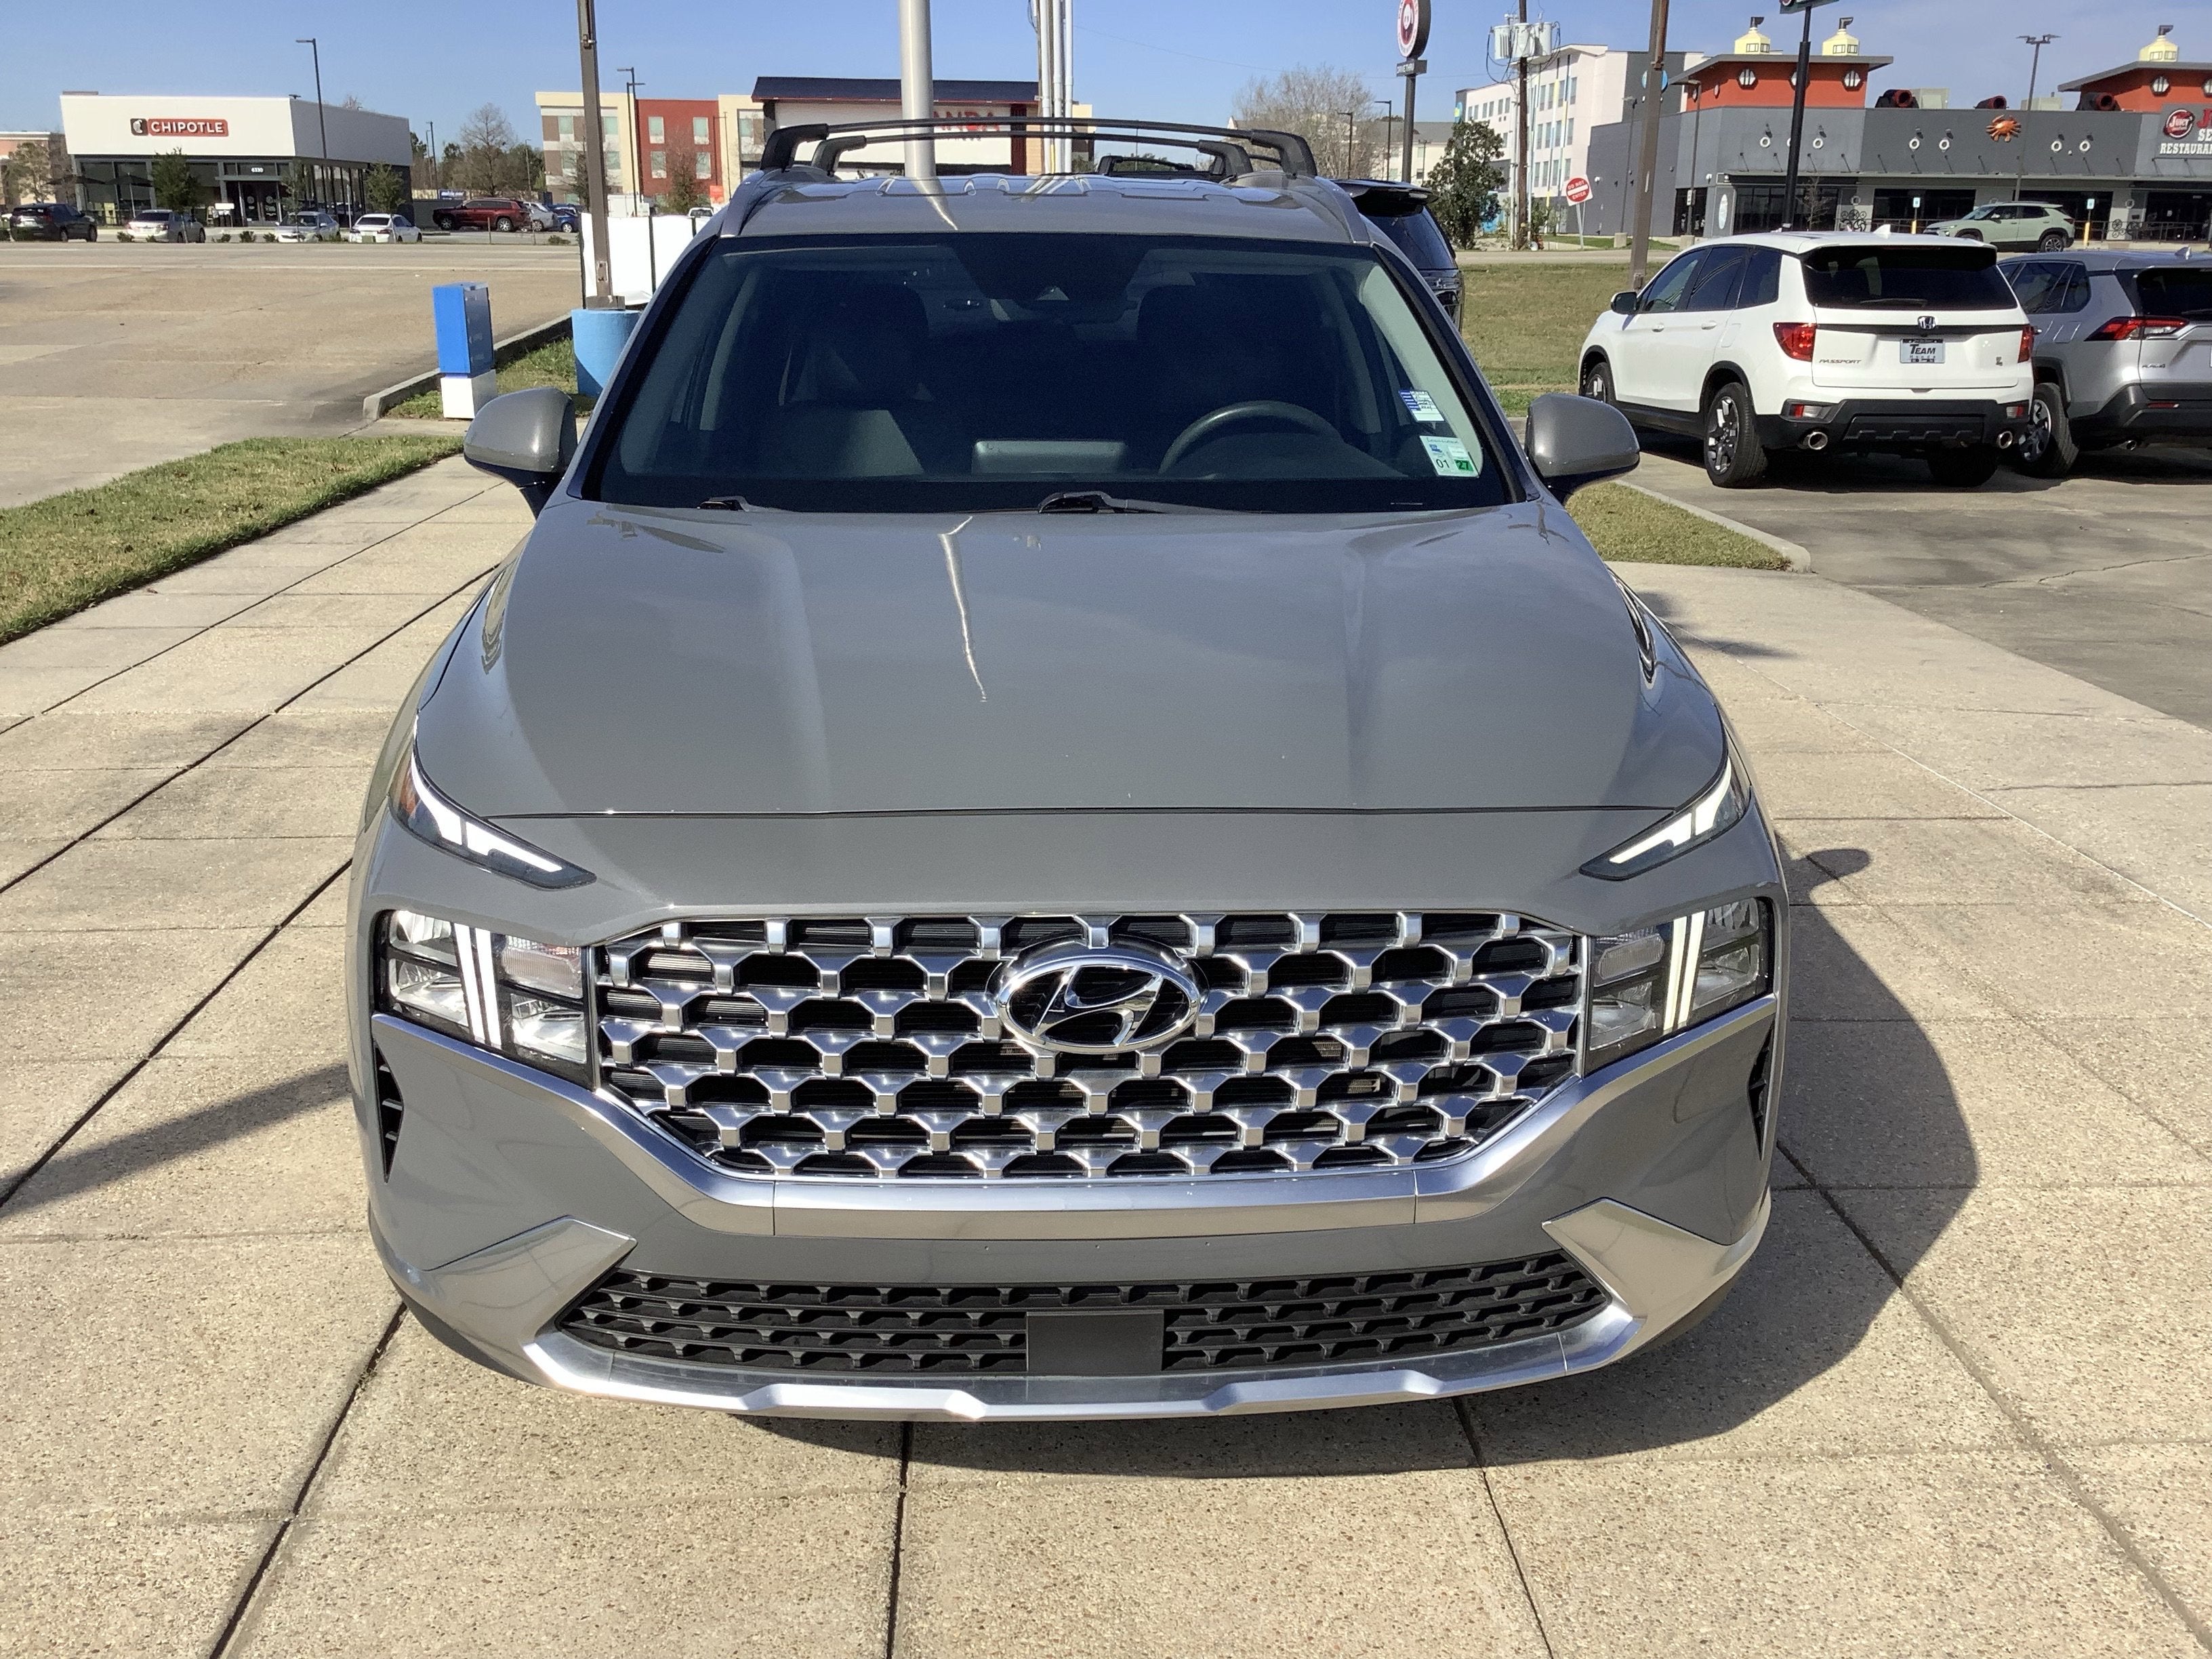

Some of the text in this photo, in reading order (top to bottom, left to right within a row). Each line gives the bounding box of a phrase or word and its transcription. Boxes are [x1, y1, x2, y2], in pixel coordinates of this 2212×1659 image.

[151, 121, 223, 133] CHIPOTLE
[2160, 142, 2212, 155] RESTAURA
[1572, 191, 1586, 200] ENTER
[1436, 459, 1469, 470] 01 27
